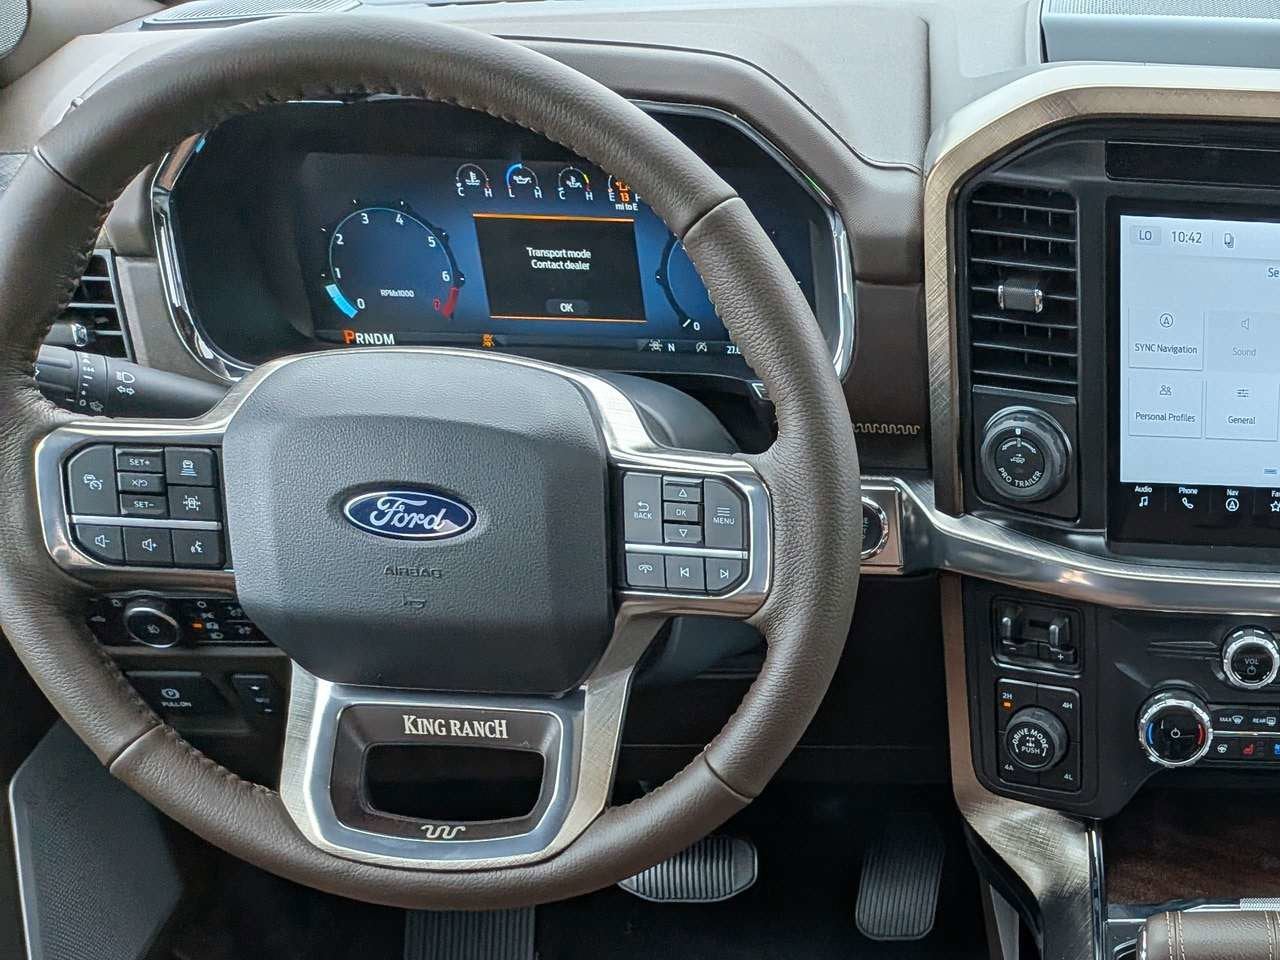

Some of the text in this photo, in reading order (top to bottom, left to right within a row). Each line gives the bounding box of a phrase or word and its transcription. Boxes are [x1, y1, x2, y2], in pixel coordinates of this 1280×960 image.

[457, 187, 465, 197] C
[484, 188, 493, 198] H
[508, 188, 515, 198] L
[534, 189, 543, 199] H
[585, 191, 593, 201] H
[609, 192, 616, 201] E
[620, 193, 630, 202] 13
[361, 213, 369, 225] 3
[395, 214, 404, 225] 4
[335, 233, 344, 245] 2
[1139, 230, 1152, 241] LO
[1171, 231, 1202, 244] 10:42
[427, 236, 436, 248] 5
[526, 247, 592, 259] Transport mode
[531, 259, 591, 270] Contact dealer
[335, 267, 341, 279] 1
[442, 270, 450, 282] 6
[357, 298, 366, 309] 0
[560, 302, 574, 313] OK
[693, 321, 700, 331] 0
[667, 343, 676, 352] N
[1134, 343, 1198, 355] SYNC Navigation
[1232, 347, 1256, 357] Sound
[1135, 411, 1196, 423] Personal Profiles
[1228, 416, 1256, 425] General
[999, 467, 1042, 488] PRO TRAILER
[1134, 485, 1153, 493] Audio
[1178, 486, 1198, 495] Phone
[1226, 488, 1239, 496] Nav
[369, 496, 447, 530] Ford
[634, 511, 652, 520] BACK
[675, 508, 687, 517] OK
[713, 517, 735, 525] MENU
[383, 565, 443, 579] AIRBAG
[1244, 657, 1259, 666] VOL
[1002, 692, 1013, 700] 2H
[402, 714, 509, 739] KING RANCH
[1012, 728, 1048, 749] DRIVE MODE
[1021, 746, 1040, 754] PUSH
